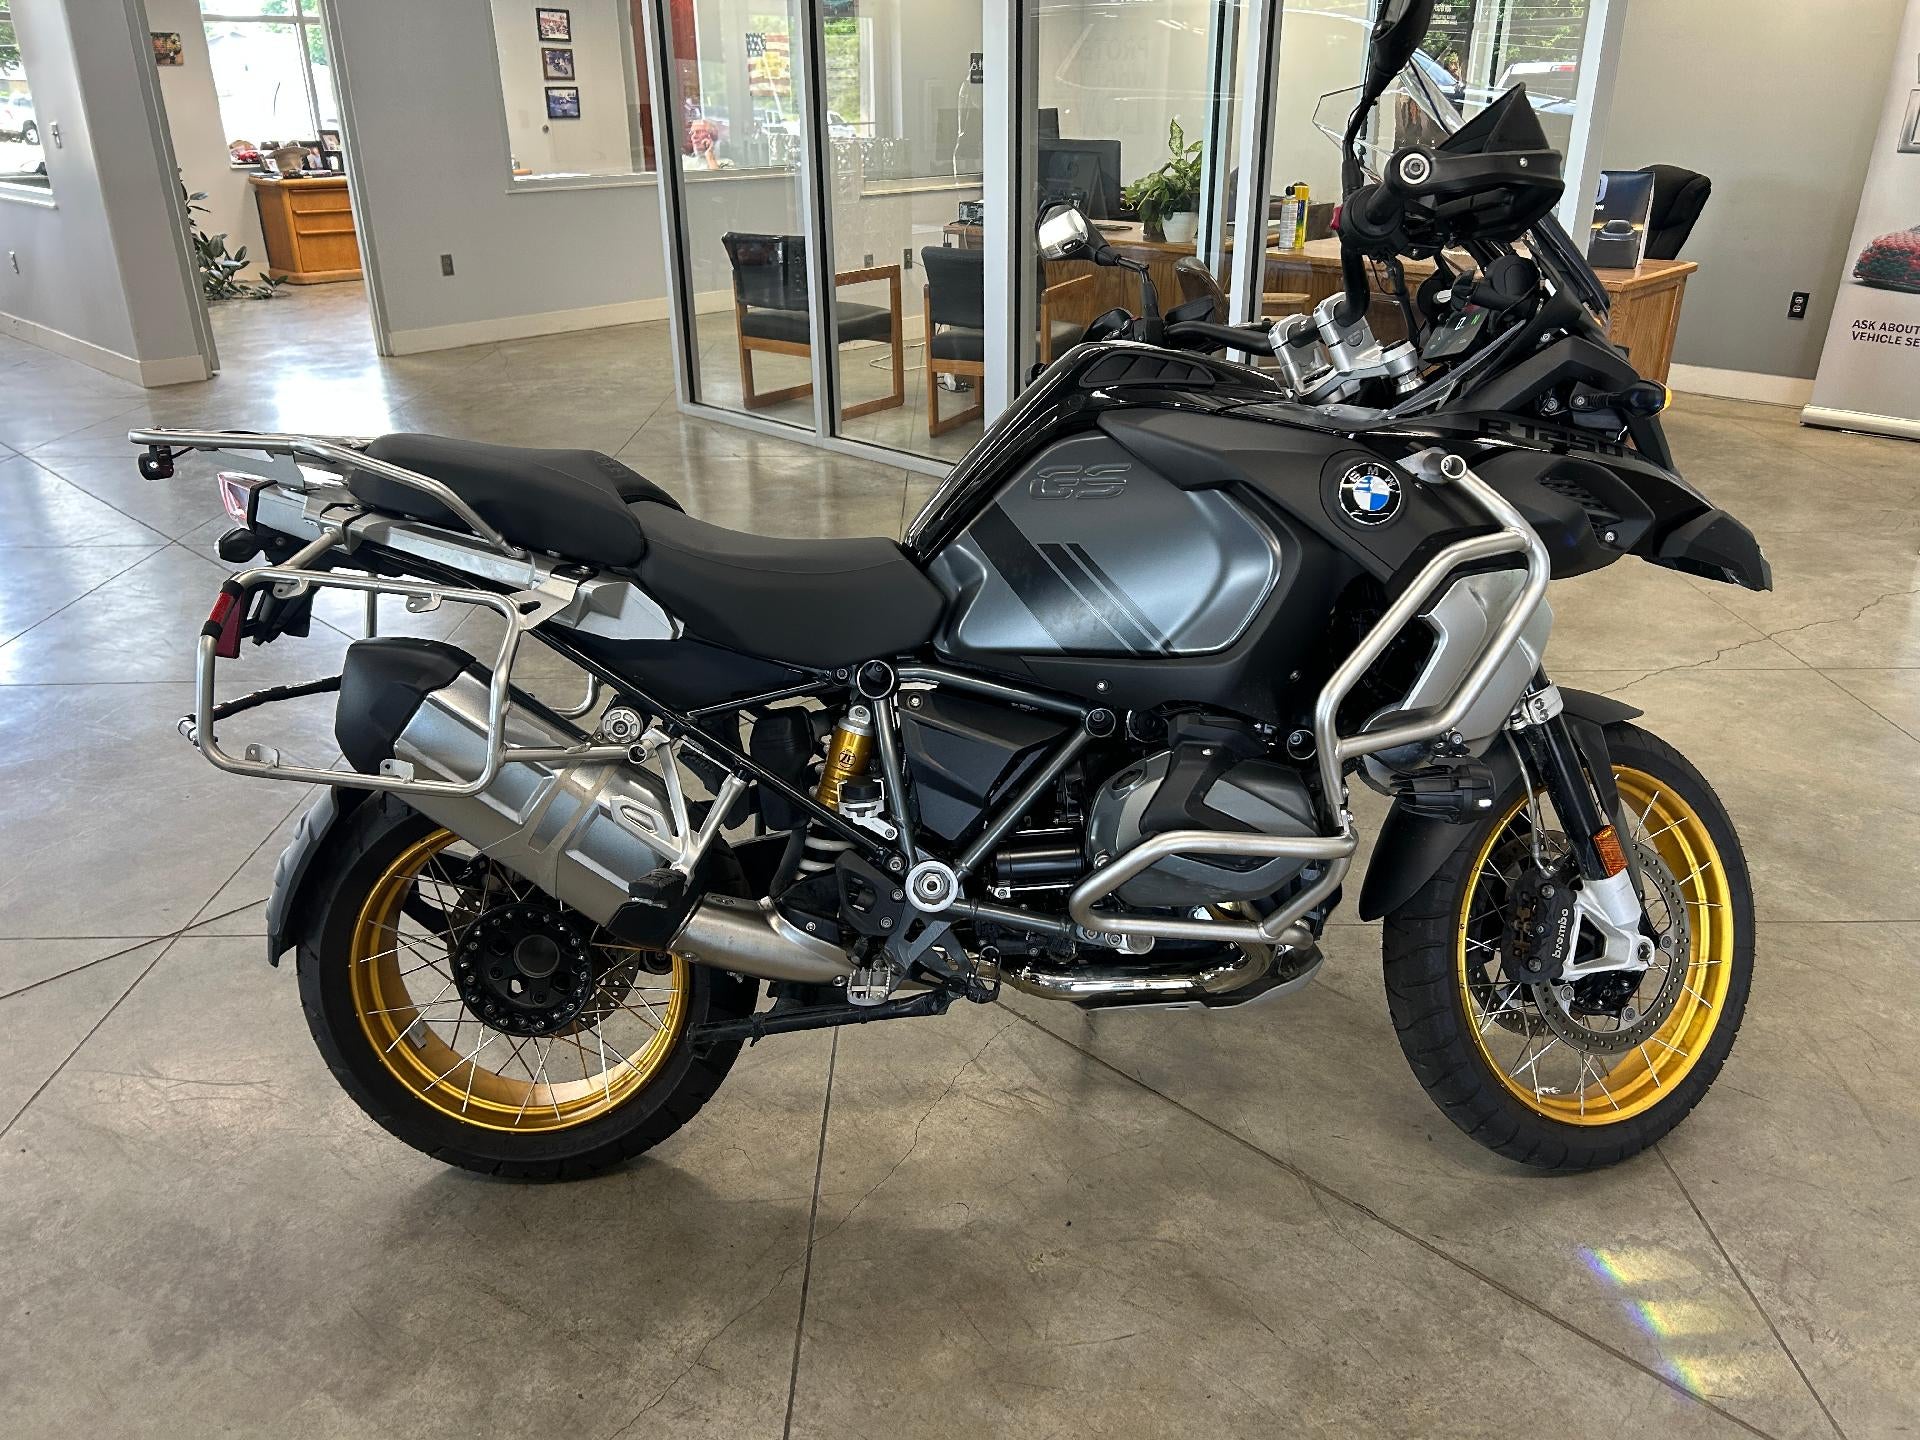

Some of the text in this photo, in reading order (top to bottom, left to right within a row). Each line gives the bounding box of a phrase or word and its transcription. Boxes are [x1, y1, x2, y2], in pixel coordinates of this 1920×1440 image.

[1851, 319, 1920, 335] ASK ABOUT
[1851, 330, 1902, 345] VEHICLE
[1029, 463, 1132, 500] GS
[1551, 908, 1569, 959] brembo
